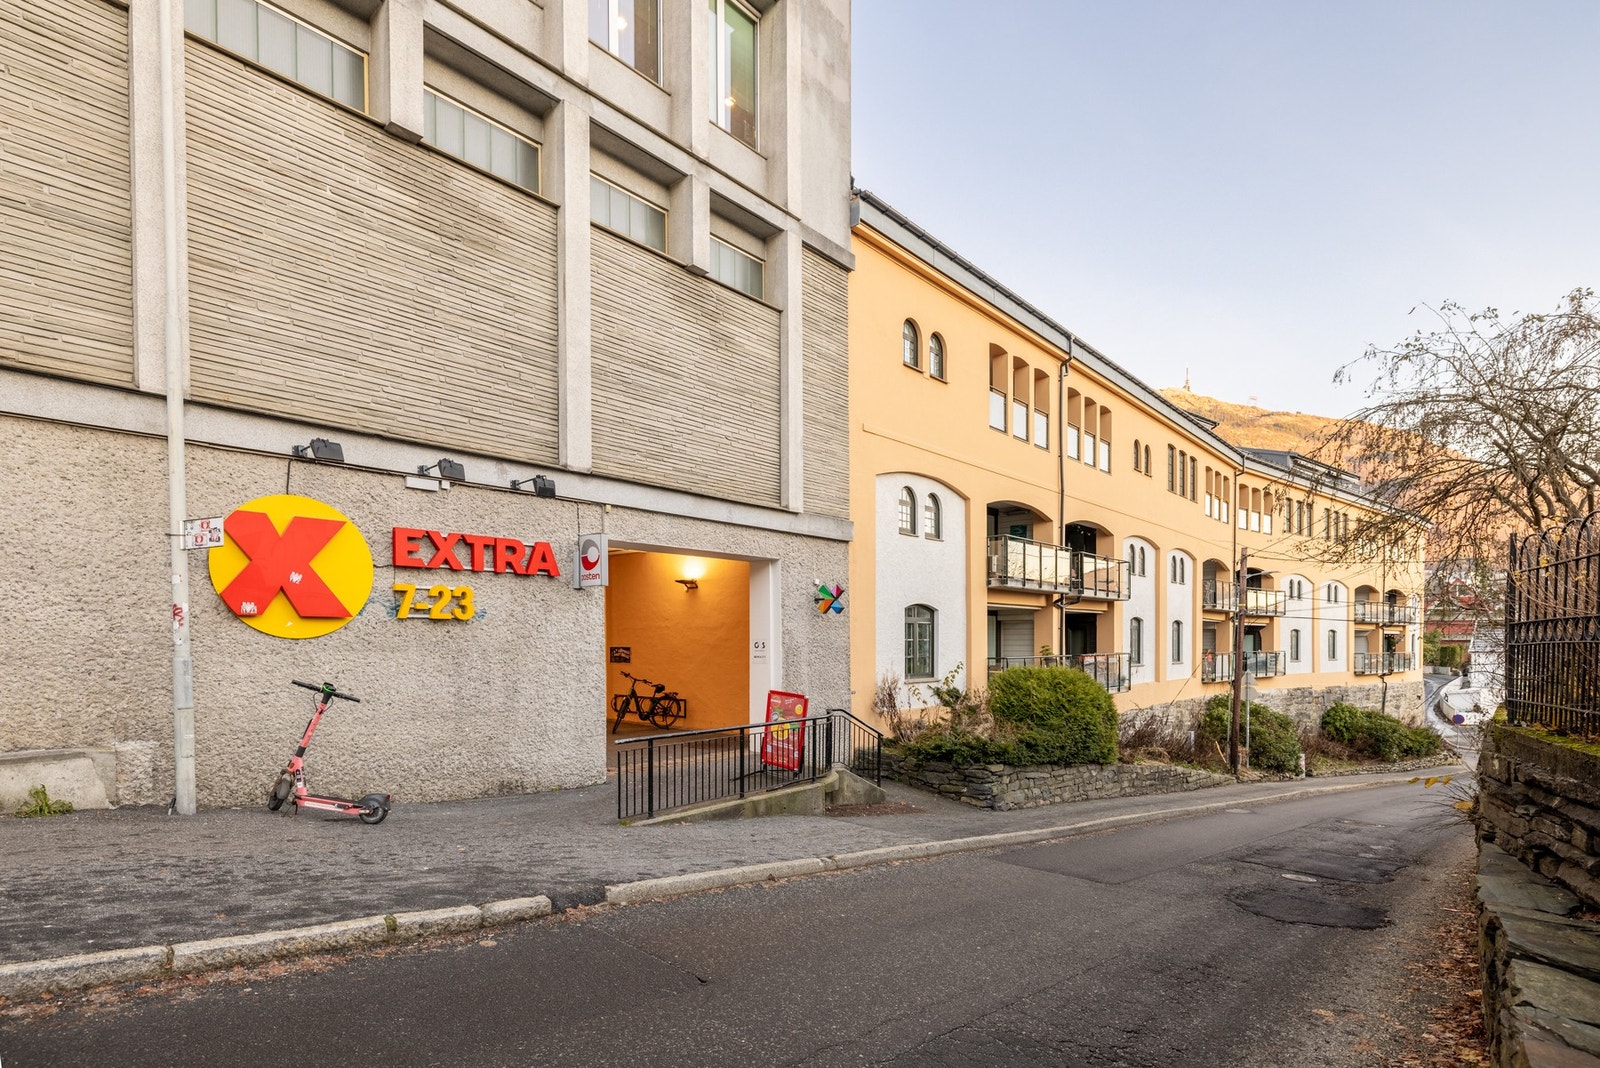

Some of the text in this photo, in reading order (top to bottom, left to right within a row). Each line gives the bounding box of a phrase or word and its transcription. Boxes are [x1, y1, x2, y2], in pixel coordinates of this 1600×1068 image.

[391, 526, 561, 577] EXTRA
[581, 572, 600, 582] posten
[392, 583, 476, 621] 7-23
